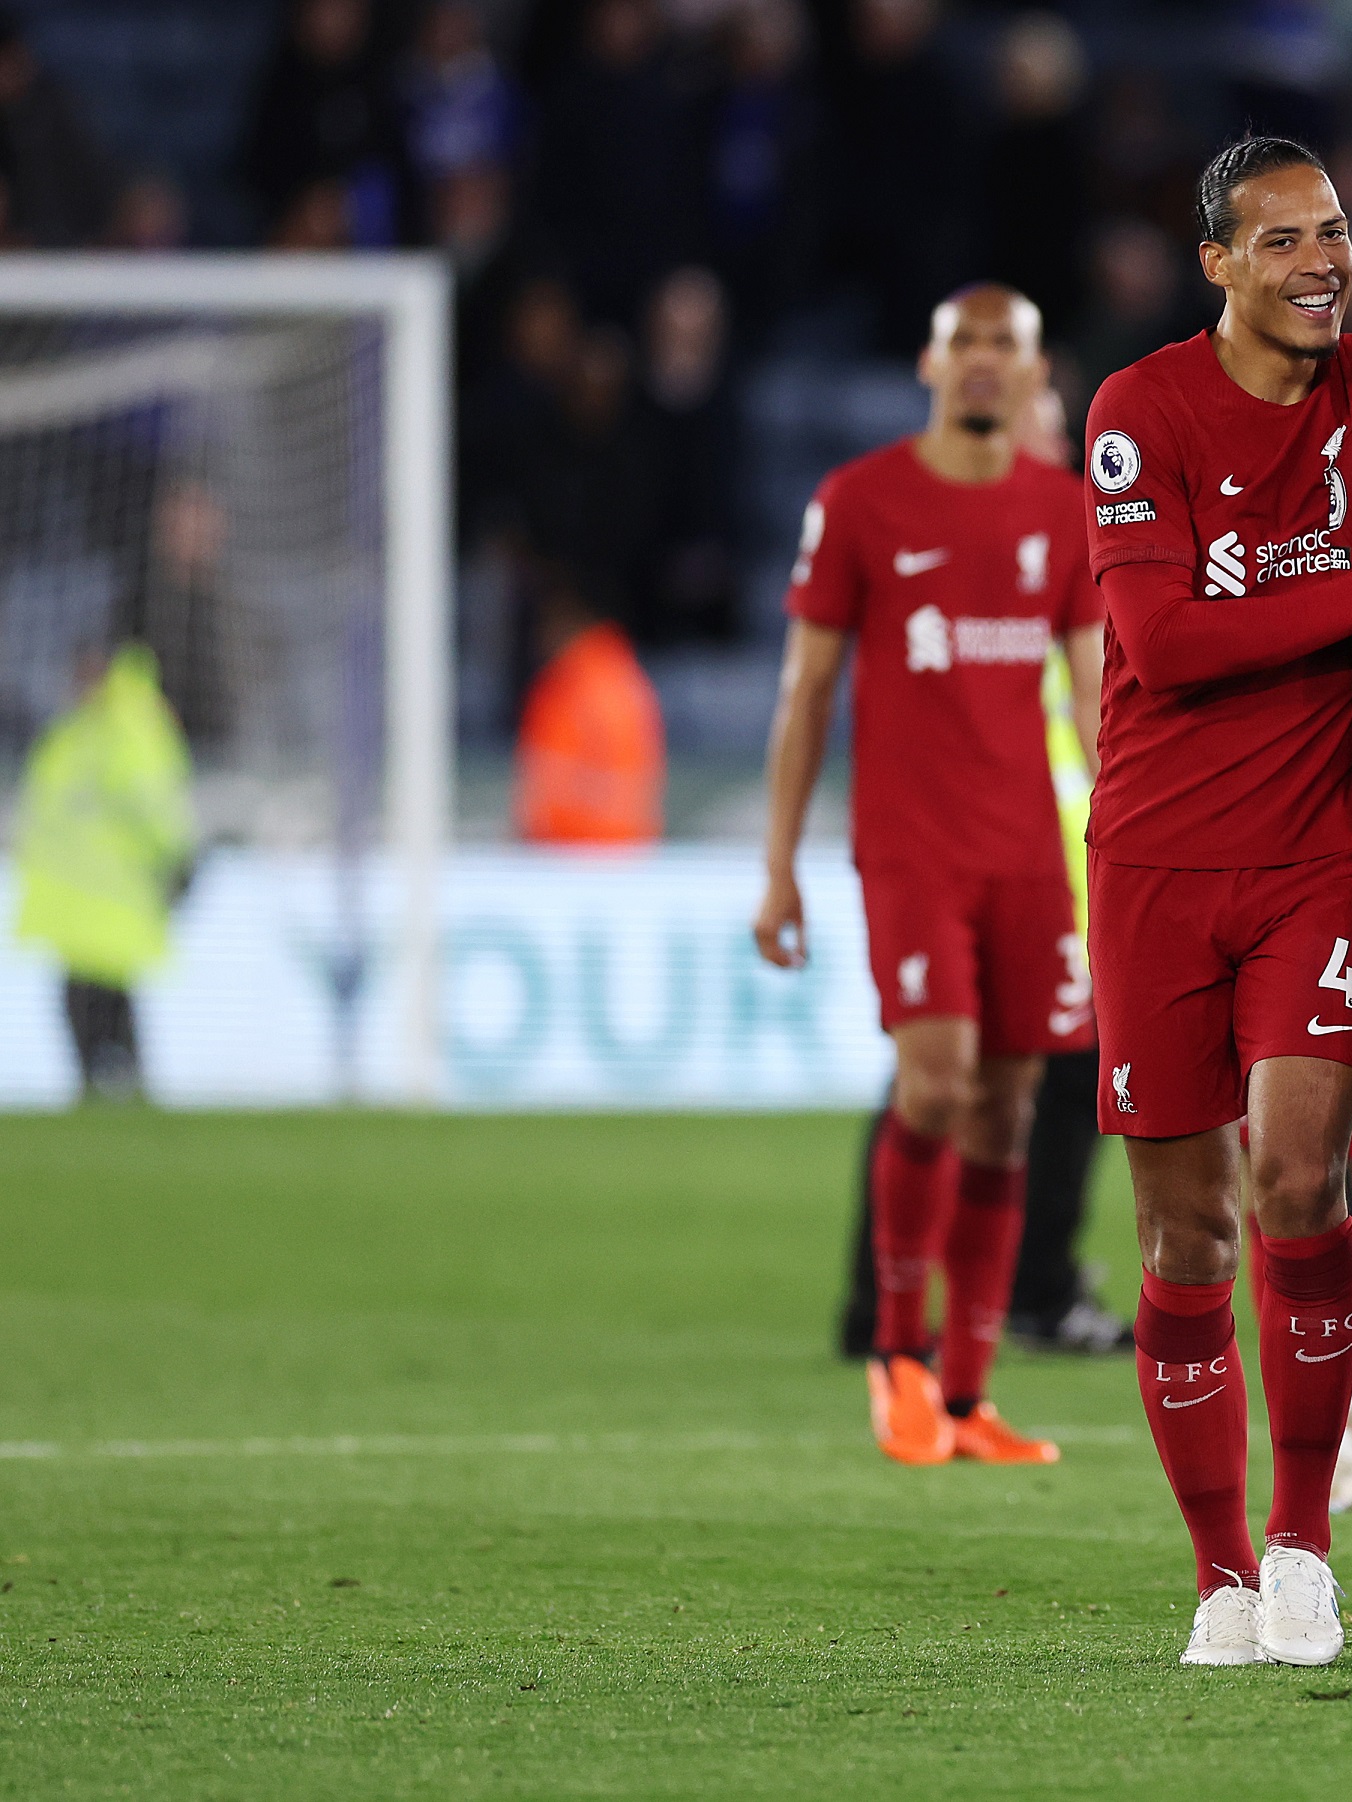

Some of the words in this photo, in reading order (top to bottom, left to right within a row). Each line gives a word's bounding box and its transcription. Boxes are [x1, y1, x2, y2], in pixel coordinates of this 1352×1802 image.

[1096, 505, 1114, 517] No
[1115, 501, 1149, 515] room
[1097, 514, 1115, 527] for
[1115, 510, 1156, 524] racism
[1255, 528, 1331, 564] standa
[1256, 552, 1331, 583] charte
